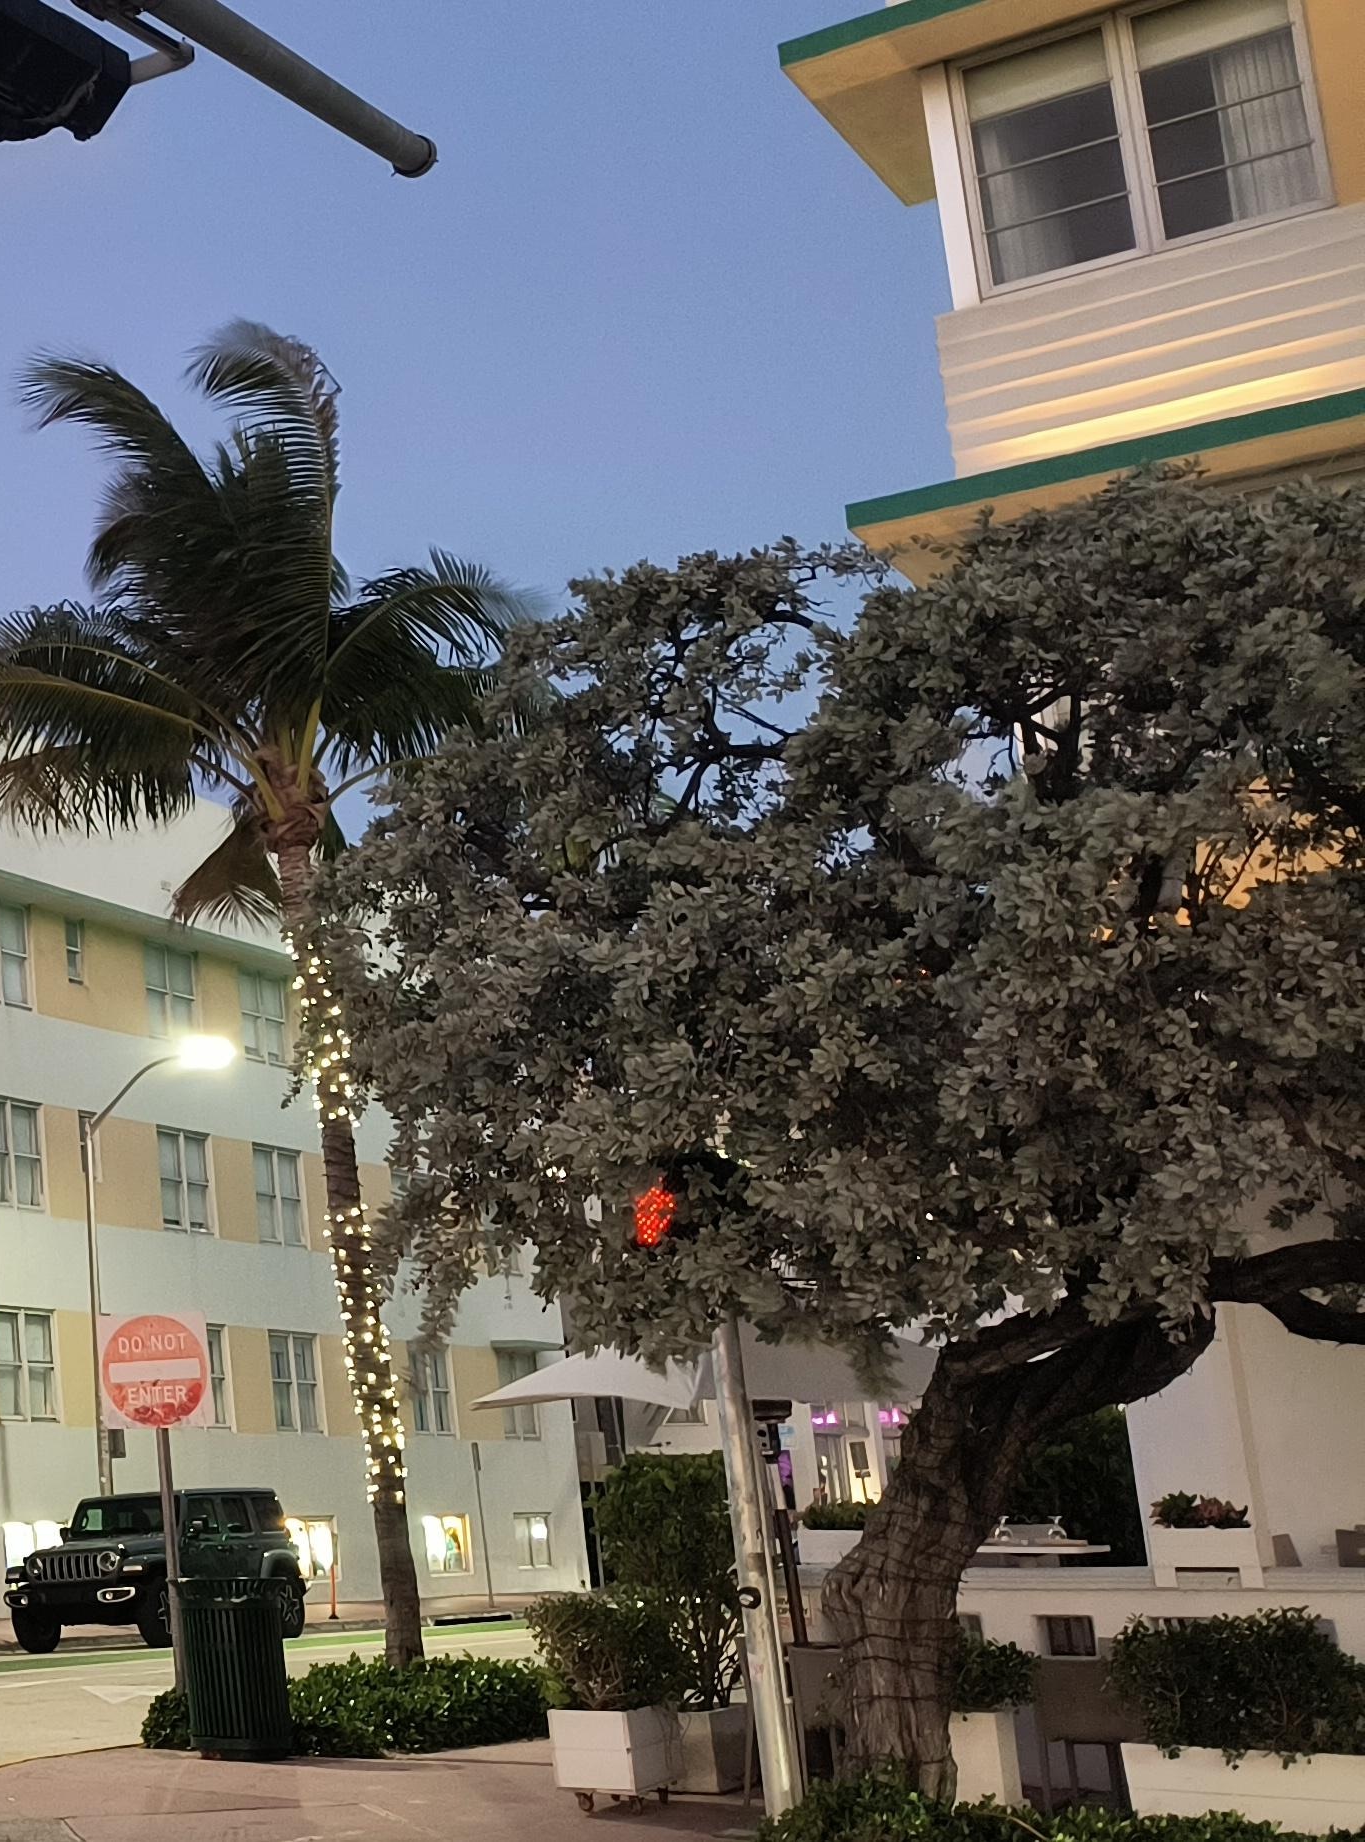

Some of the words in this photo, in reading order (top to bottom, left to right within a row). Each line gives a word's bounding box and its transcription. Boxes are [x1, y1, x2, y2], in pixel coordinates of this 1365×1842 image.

[118, 1337, 143, 1353] DO
[151, 1333, 187, 1351] NOT
[128, 1386, 187, 1404] ENTER
